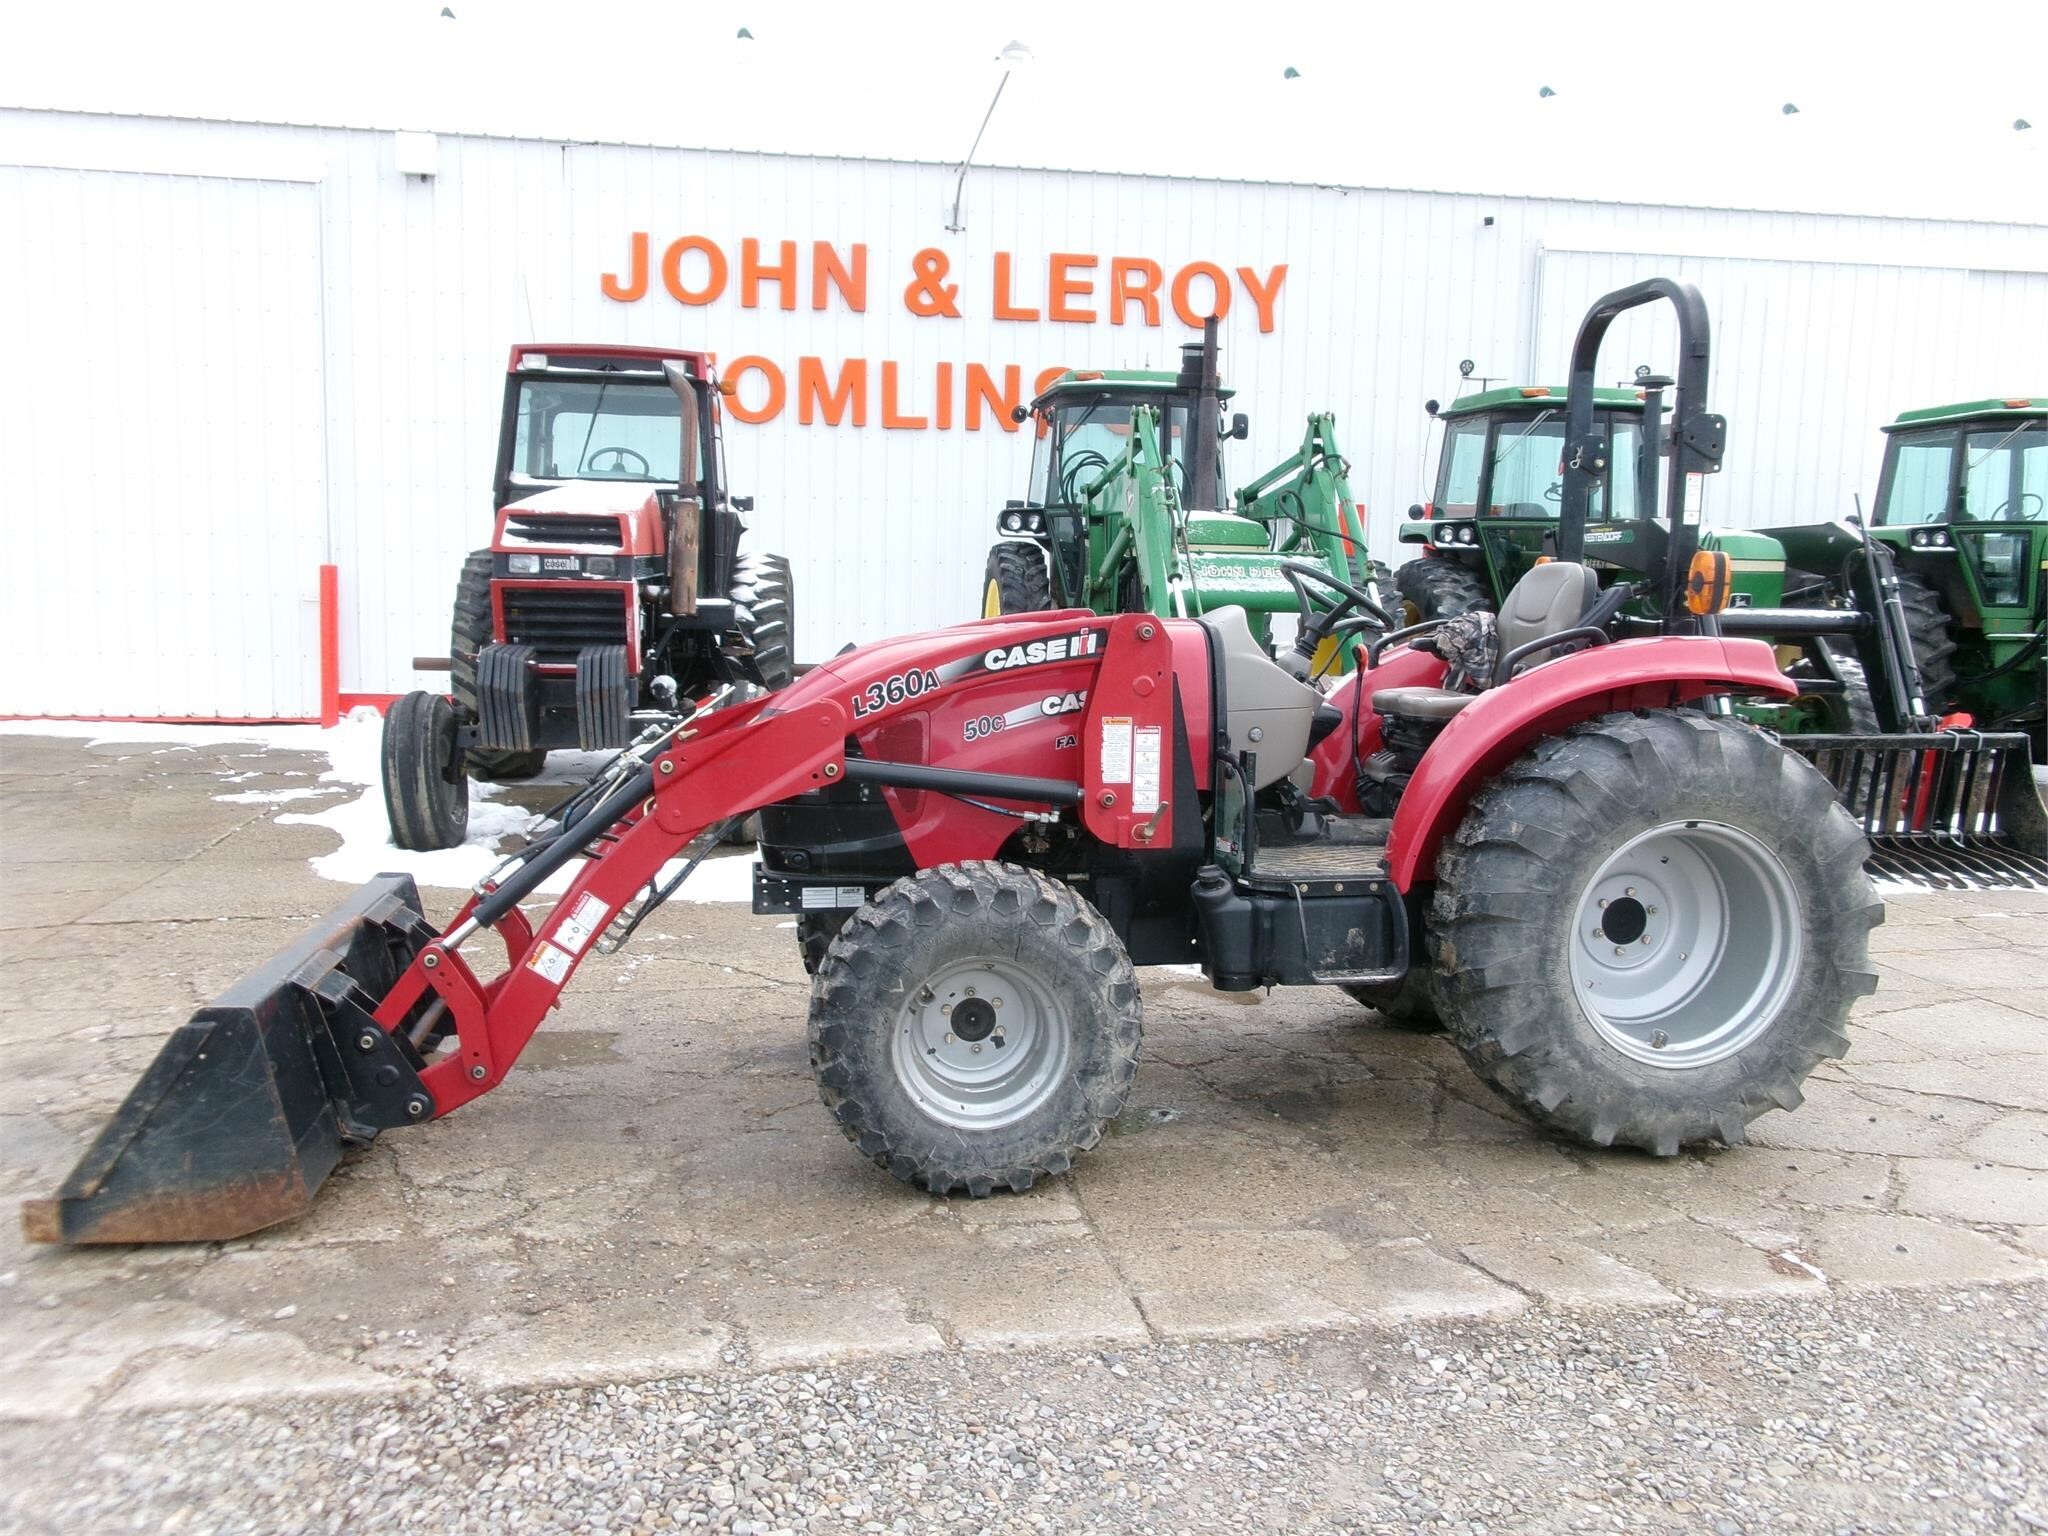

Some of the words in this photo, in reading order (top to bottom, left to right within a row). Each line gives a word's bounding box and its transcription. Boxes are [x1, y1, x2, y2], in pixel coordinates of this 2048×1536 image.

[601, 232, 867, 312] JOHN
[904, 247, 962, 319] &
[992, 252, 1290, 333] LEROY
[1199, 564, 1246, 577] JOHN
[984, 637, 1067, 671] CASE
[852, 668, 940, 720] L360A
